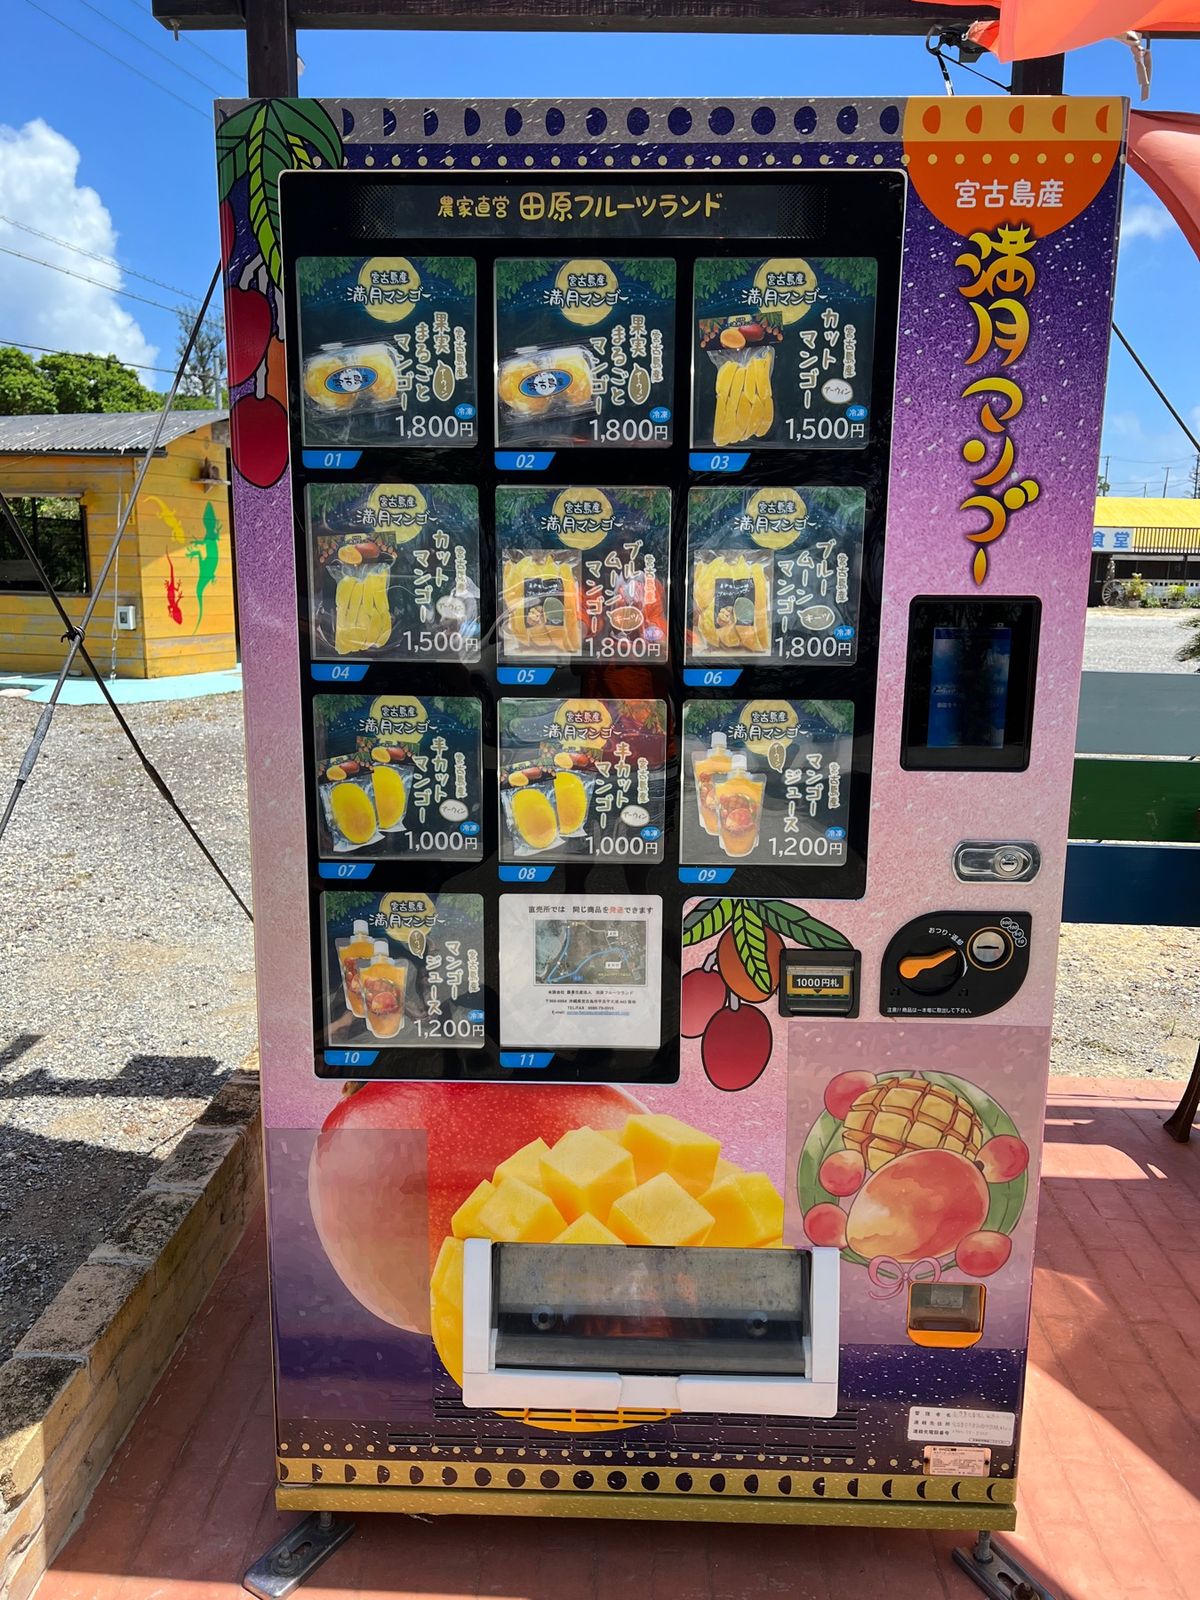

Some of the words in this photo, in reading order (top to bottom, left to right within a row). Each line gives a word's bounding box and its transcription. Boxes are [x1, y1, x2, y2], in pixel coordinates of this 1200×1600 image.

[954, 180, 1064, 208] 宮古島産
[438, 196, 510, 218] 農家直営
[520, 192, 724, 222] 田原フルーツランド
[371, 272, 409, 284] 宮古島産
[568, 274, 607, 287] 宮古島産
[767, 272, 806, 286] 宮古島産
[347, 286, 432, 304] 満月マンゴー
[543, 290, 629, 308] 満月マンゴー
[741, 288, 828, 306] 満月マンゴー
[434, 311, 450, 354] 果実
[630, 314, 646, 357] 果実
[822, 308, 840, 369] カット
[415, 322, 433, 402] まるごと
[611, 325, 629, 405] まるごと
[799, 330, 819, 409] マンゴー
[394, 334, 414, 410] マンゴー
[590, 337, 609, 415] マンゴー
[954, 223, 1040, 586] 満月マンゴー
[395, 415, 473, 437] 1,800円
[589, 419, 668, 442] 1,800円
[785, 418, 864, 442] 1,500円
[324, 454, 342, 467] 01
[516, 454, 535, 468] 02
[710, 455, 729, 470] 03
[565, 502, 602, 515] 宮古島産
[759, 502, 796, 514] 宮古島産
[356, 510, 438, 527] 満月マンゴー
[541, 517, 623, 533] 満月マンゴー
[734, 516, 817, 533] 満月マンゴー
[1092, 531, 1130, 548] 食堂
[433, 530, 449, 587] カット
[624, 539, 643, 597] ブルー
[816, 538, 836, 596] ブルー
[413, 550, 433, 623] マンゴー
[604, 551, 622, 606] ムーン
[796, 551, 814, 605] ムーン
[586, 561, 603, 633] マンゴー
[777, 560, 796, 633] マンゴー
[403, 631, 478, 653] 1,500円
[585, 638, 660, 659] 1,800円
[775, 637, 851, 659] 1,800円
[331, 667, 350, 679] 04
[517, 670, 535, 683] 05
[704, 671, 722, 684] 06
[382, 706, 417, 717] 宮古島産
[566, 712, 600, 723] 宮古島産
[752, 711, 788, 723] 宮古島産
[359, 719, 438, 734] 満月マンゴー
[543, 725, 622, 740] 満月マンゴー
[728, 725, 808, 741] 満月マンゴー
[413, 756, 432, 823] マンゴー
[806, 753, 824, 816] マンゴー
[596, 761, 613, 828] マンゴー
[784, 769, 802, 832] ジュース
[405, 832, 477, 851] 1,000円
[586, 836, 658, 856] 1,000円
[768, 837, 842, 857] 1,200円
[338, 865, 356, 876] 07
[518, 868, 536, 880] 08
[698, 870, 716, 882] 09
[369, 913, 446, 928] 満月マンゴー
[445, 941, 463, 1000] マンゴー
[426, 955, 443, 1015] ジュース
[796, 978, 840, 987] 1000円札
[414, 1020, 484, 1039] 1,200円
[344, 1052, 360, 1063] 10
[520, 1054, 534, 1065] 11
